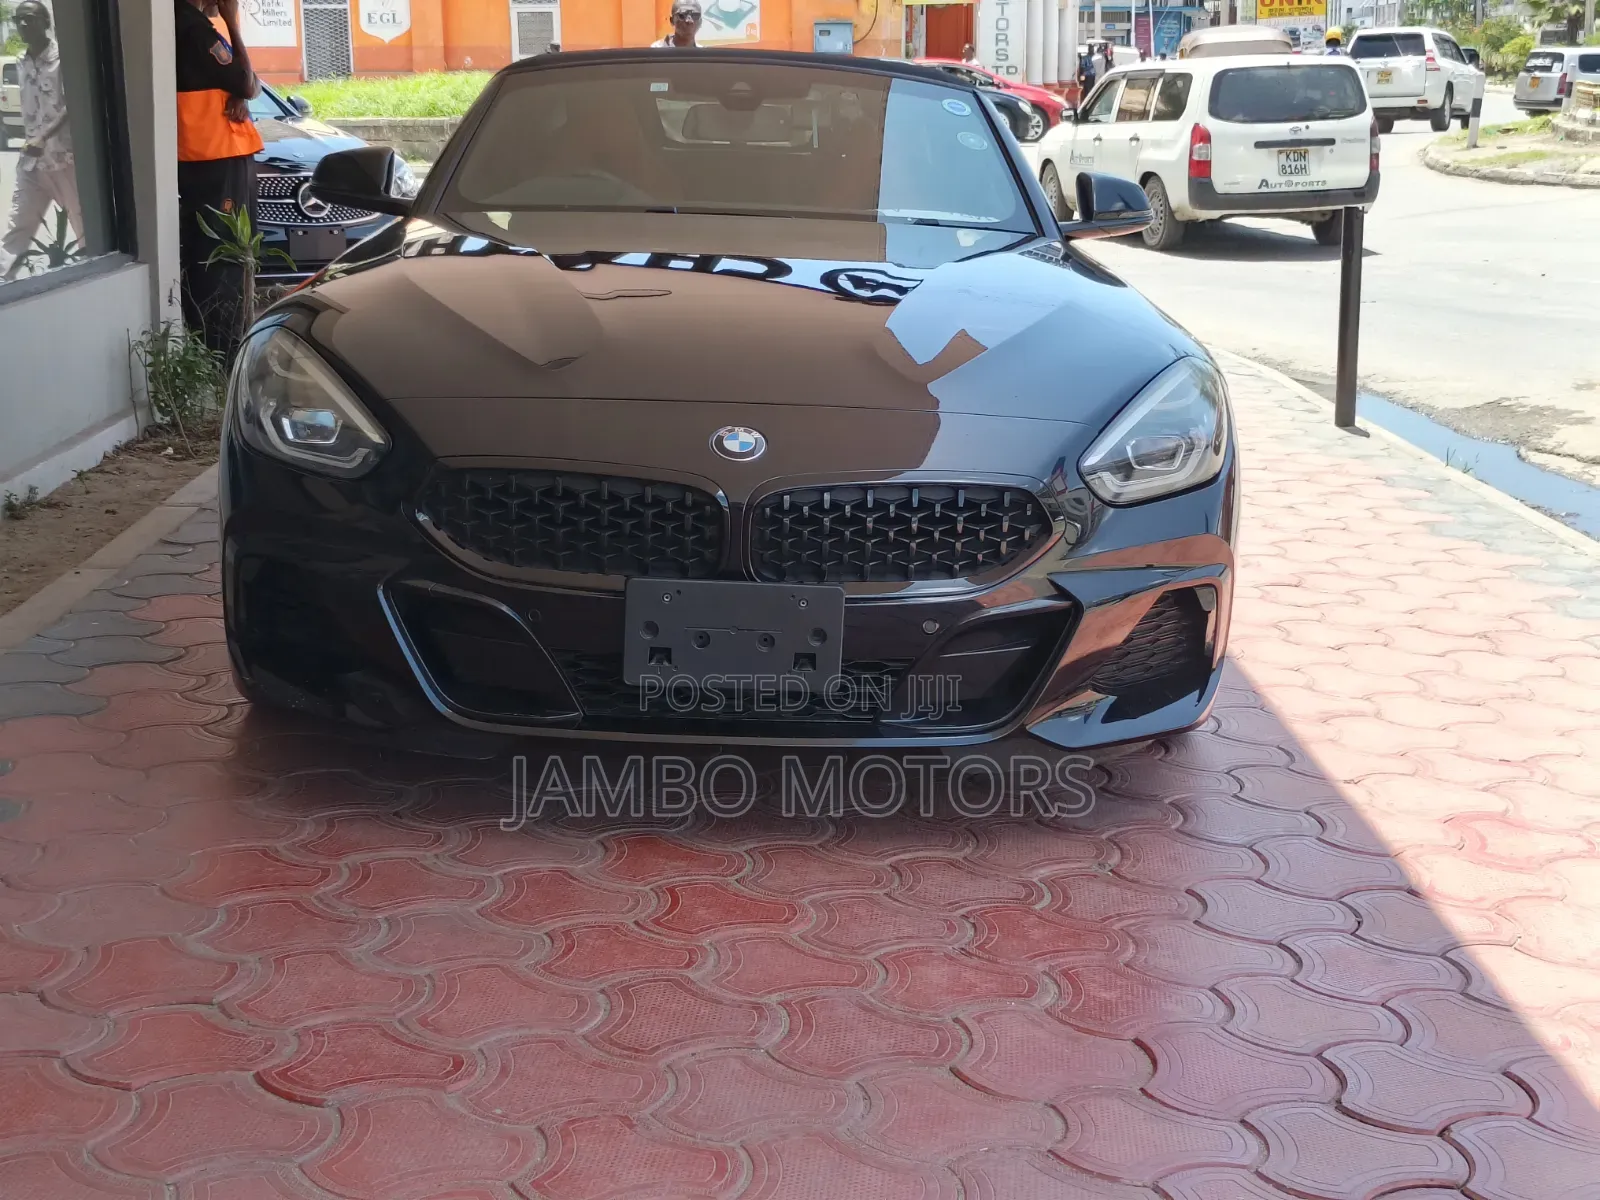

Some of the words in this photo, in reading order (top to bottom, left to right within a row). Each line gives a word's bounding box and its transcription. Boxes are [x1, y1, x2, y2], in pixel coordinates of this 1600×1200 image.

[263, 18, 292, 26] Limited
[367, 12, 403, 24] EGL
[995, 0, 1010, 62] TORS
[1285, 151, 1307, 162] KDN
[1281, 164, 1308, 175] 816H
